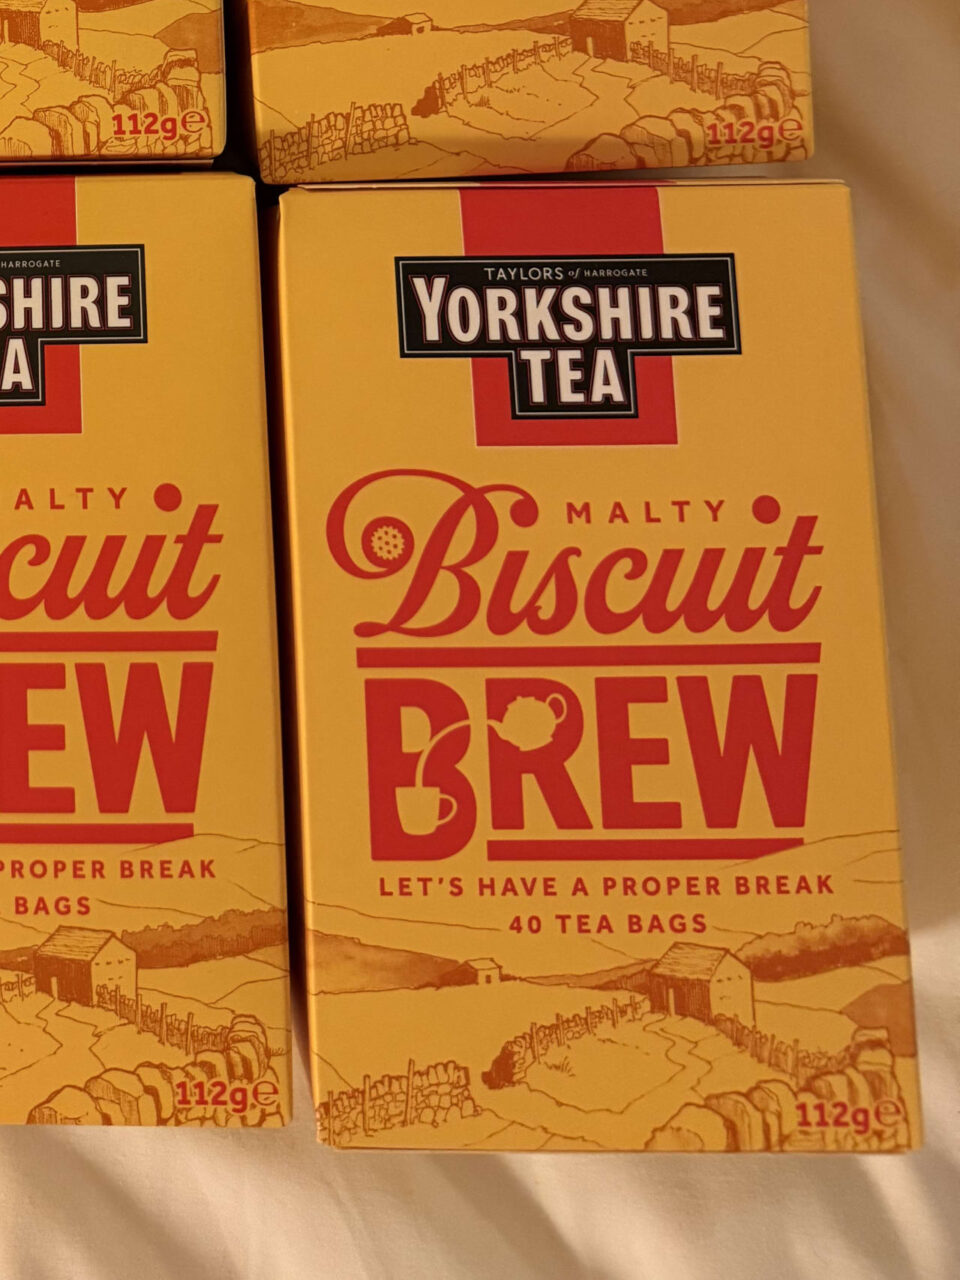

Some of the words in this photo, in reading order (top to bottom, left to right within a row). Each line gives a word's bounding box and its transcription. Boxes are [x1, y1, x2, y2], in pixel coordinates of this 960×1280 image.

[1, 260, 60, 268] HARROGATE
[484, 265, 564, 281] TAYLORS
[584, 268, 648, 278] HARROGATE
[411, 276, 725, 343] YORKSHIRE
[519, 348, 626, 404] TEA
[566, 500, 724, 525] MALTY
[325, 468, 824, 639] Biscuit
[364, 674, 819, 862] BREW
[120, 859, 215, 880] BREAK
[379, 876, 464, 897] LET'S
[477, 876, 557, 897] HAVE
[572, 877, 588, 896] A
[603, 876, 720, 896] PROPER
[735, 874, 835, 896] BREAK
[14, 896, 90, 917] BAGS
[509, 914, 541, 934] 40
[555, 914, 613, 934] TEA
[627, 913, 706, 934] BAGS
